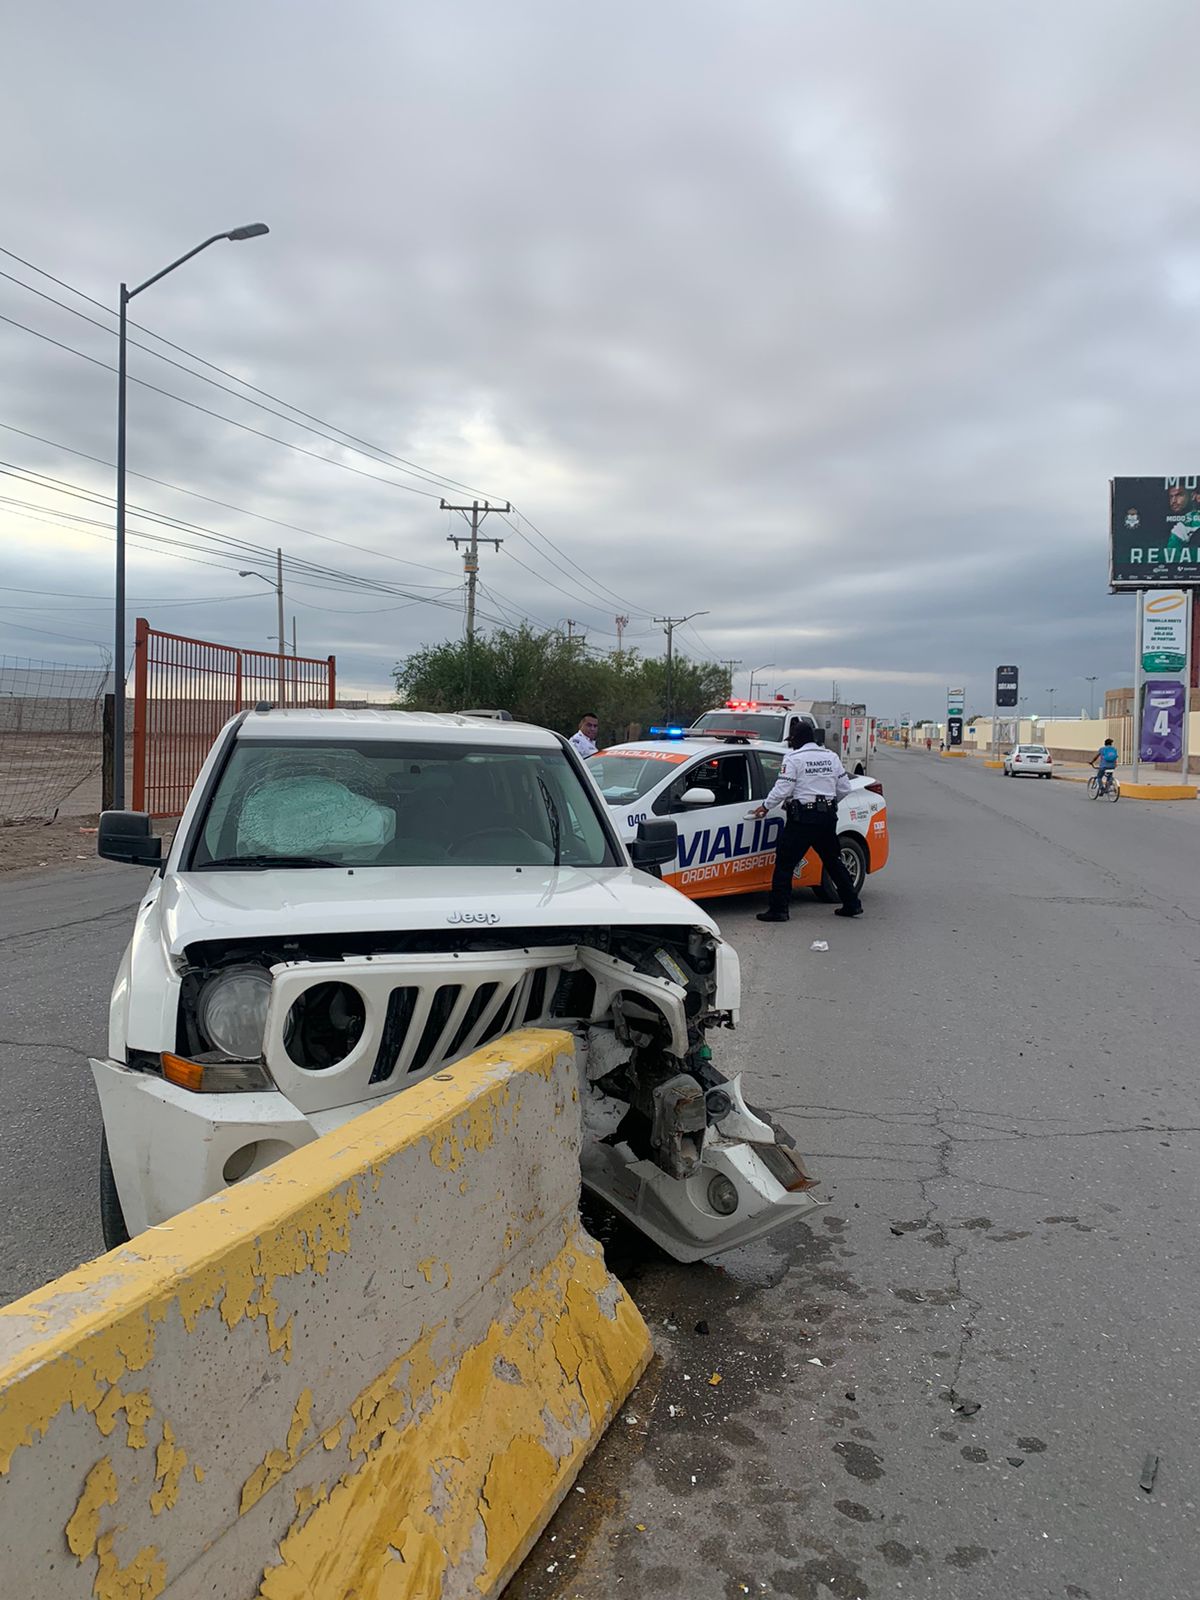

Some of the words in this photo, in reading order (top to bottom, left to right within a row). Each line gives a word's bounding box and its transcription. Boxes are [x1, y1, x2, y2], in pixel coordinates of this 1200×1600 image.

[1153, 710, 1171, 736] 4
[805, 759, 832, 767] TRANSITO
[681, 864, 721, 885] ORDEN
[722, 862, 730, 876] Y
[732, 852, 777, 874] RESPETO
[446, 911, 501, 926] Jeep
